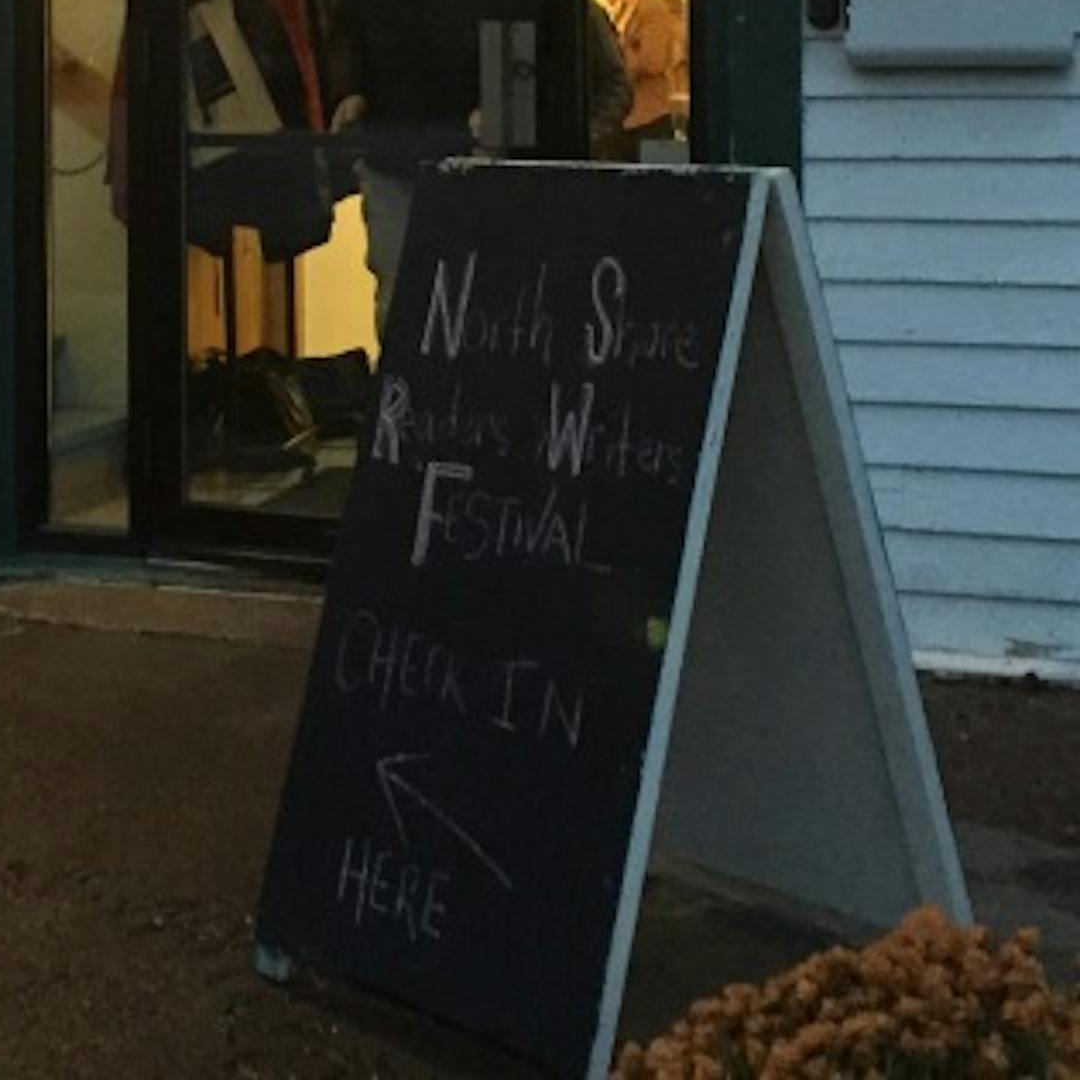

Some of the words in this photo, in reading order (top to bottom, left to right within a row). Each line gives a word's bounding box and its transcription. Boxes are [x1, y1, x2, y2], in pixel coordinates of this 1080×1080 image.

[420, 250, 553, 363] North
[585, 256, 700, 368] Shore
[335, 608, 467, 714] CHECK
[490, 660, 583, 749] IN
[336, 838, 451, 943] HERE
